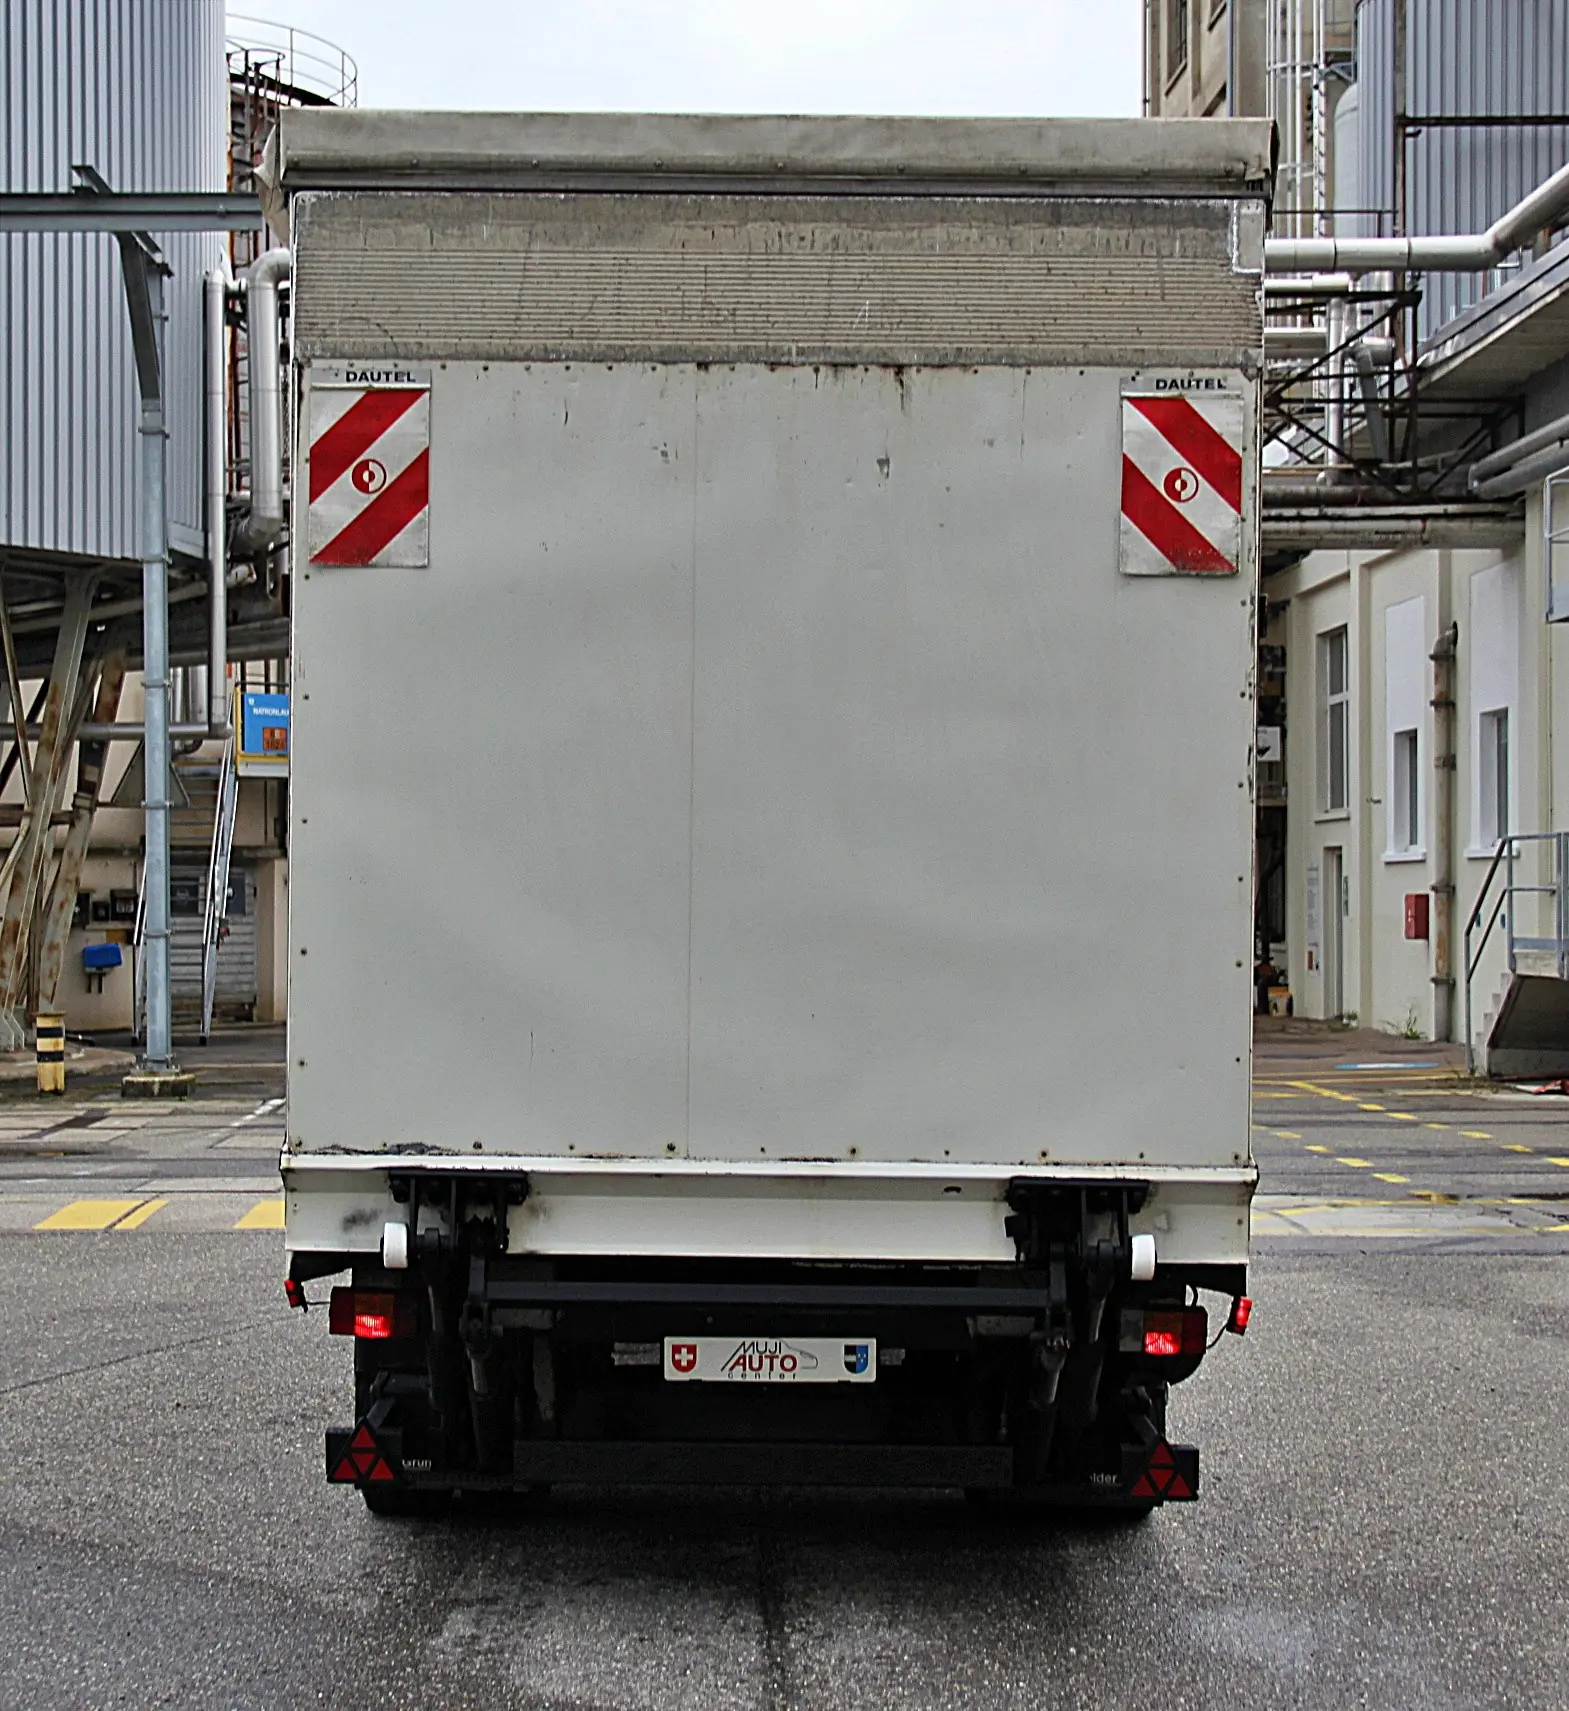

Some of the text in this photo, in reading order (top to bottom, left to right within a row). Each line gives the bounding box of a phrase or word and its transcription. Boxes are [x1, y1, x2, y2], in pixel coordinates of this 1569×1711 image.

[345, 371, 416, 382] DAUTEL
[1155, 378, 1228, 390] DAUTEL
[729, 1354, 797, 1372] AUTO
